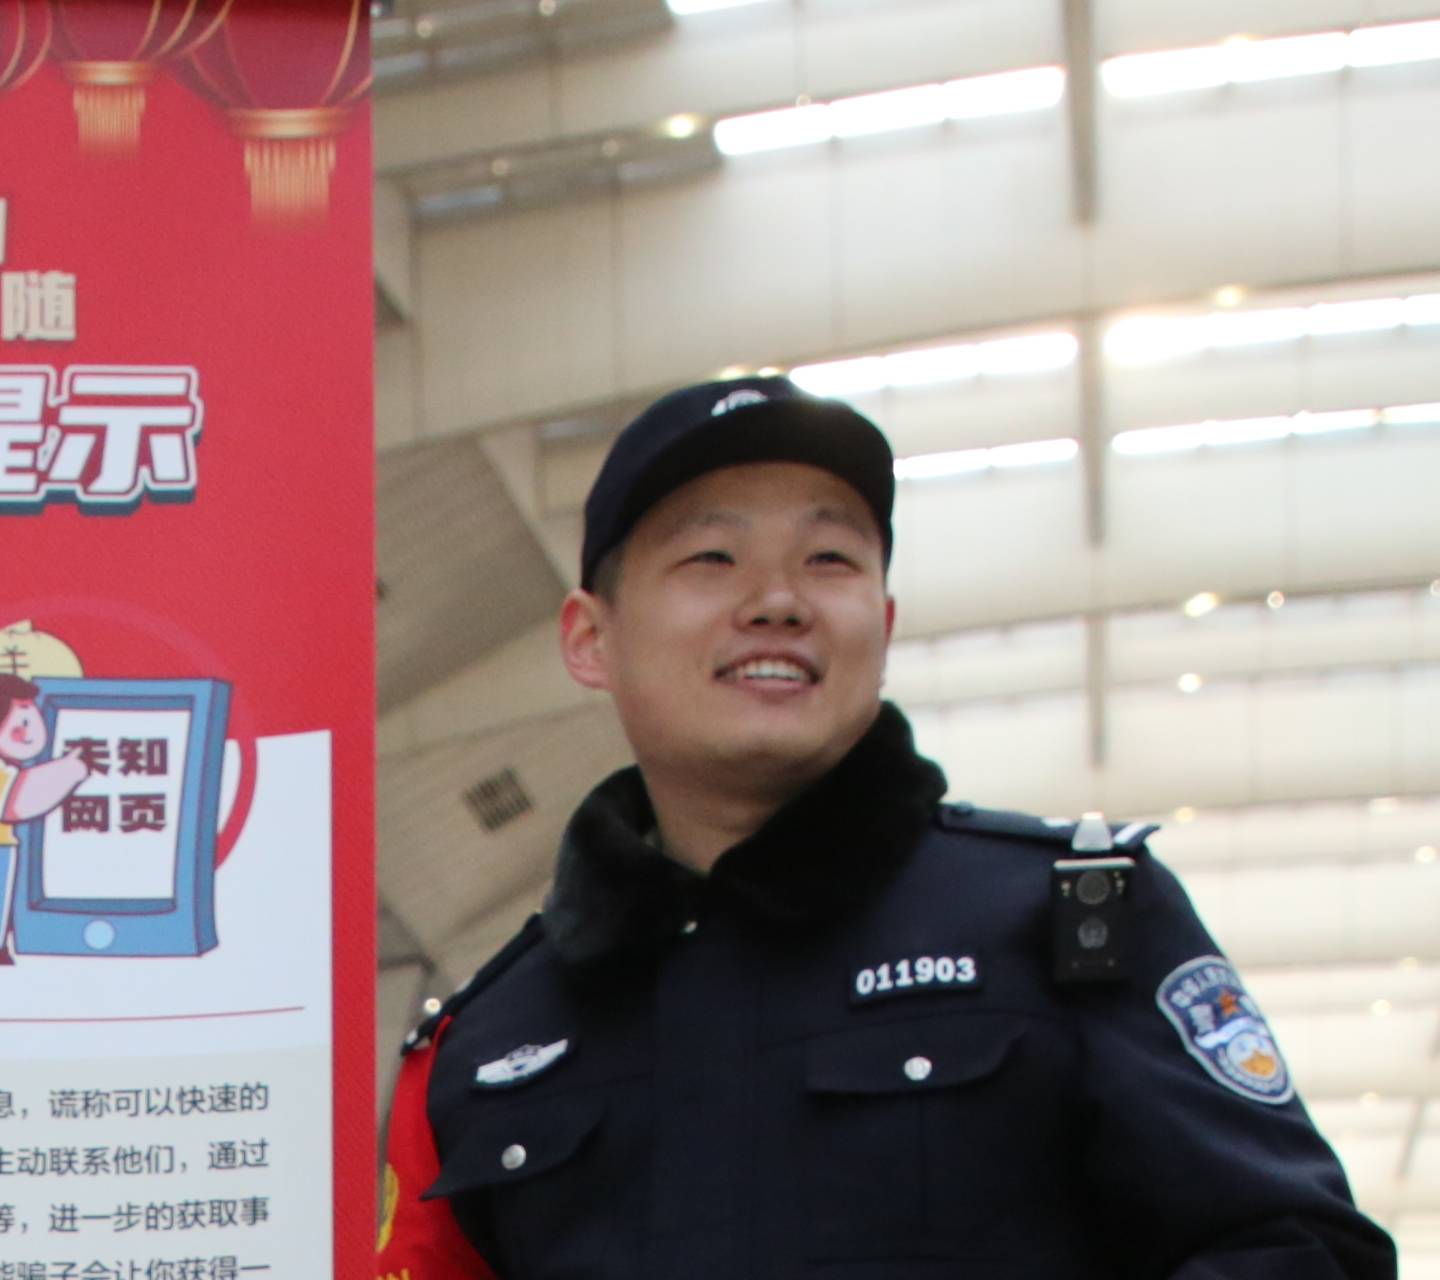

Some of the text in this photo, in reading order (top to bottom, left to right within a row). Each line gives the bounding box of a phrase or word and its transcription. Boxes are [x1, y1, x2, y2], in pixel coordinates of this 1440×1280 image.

[62, 737, 168, 777] 未知
[62, 792, 167, 834] 网页
[854, 954, 977, 998] 011903
